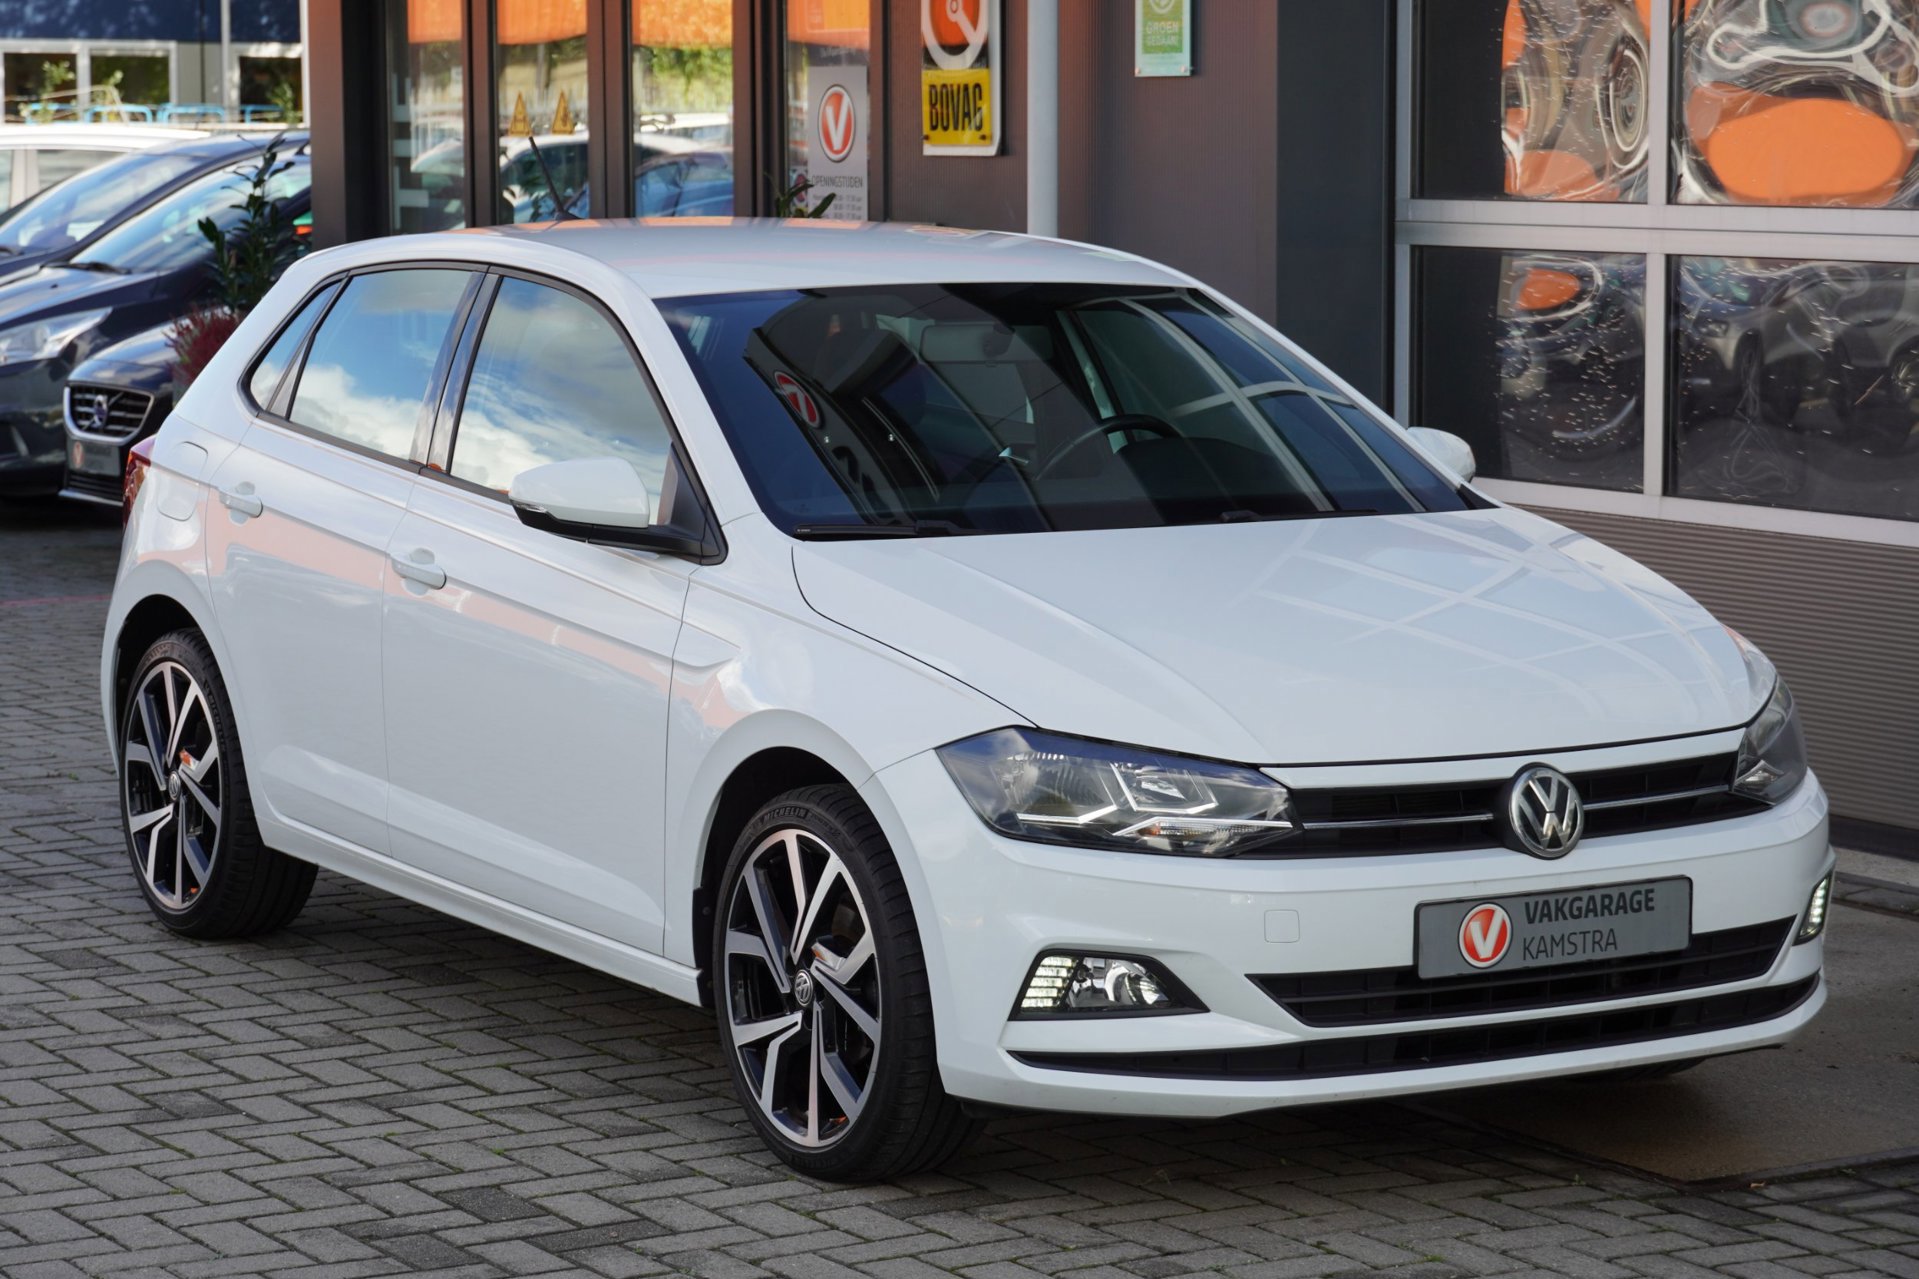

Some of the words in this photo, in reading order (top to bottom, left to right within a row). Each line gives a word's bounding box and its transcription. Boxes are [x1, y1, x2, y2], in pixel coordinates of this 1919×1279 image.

[929, 82, 983, 132] BOVAG
[761, 805, 808, 823] MICHELIN
[1524, 888, 1655, 925] VAKGARAGE
[1468, 907, 1506, 960] V
[1522, 927, 1618, 961] KAMSTRA
